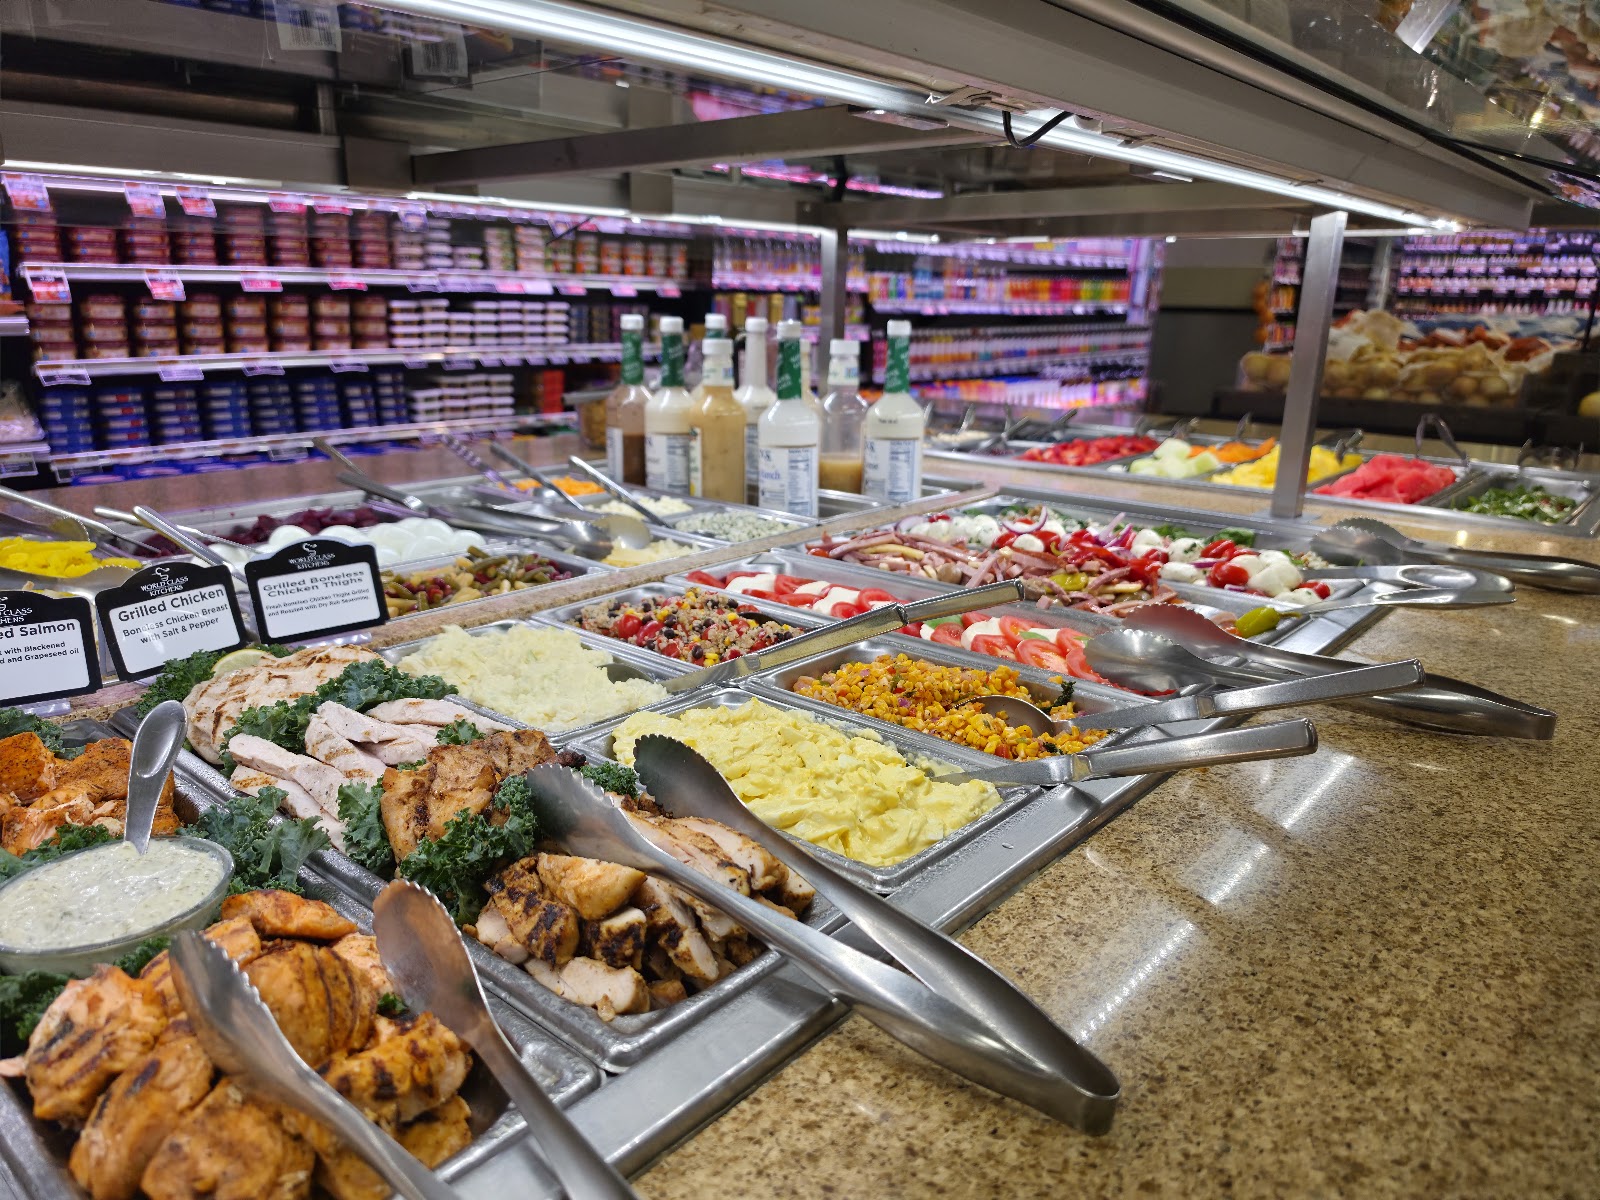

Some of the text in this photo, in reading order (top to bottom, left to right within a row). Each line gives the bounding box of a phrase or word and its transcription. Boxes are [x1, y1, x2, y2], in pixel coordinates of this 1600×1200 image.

[140, 575, 189, 592] WORLD CLASS
[263, 570, 364, 592] Grilled Boneless
[268, 577, 363, 597] Chicken Thighs
[149, 584, 184, 597] KITCHENS
[3, 607, 33, 617] CLASS
[118, 588, 225, 622] Grilled Chicken
[0, 615, 25, 625] HENS
[122, 603, 229, 637] Boneless Chicken Breast
[19, 622, 75, 637] Salmon
[140, 617, 219, 644] with Salt & Pepper
[4, 646, 22, 655] with
[24, 641, 66, 653] Blackened
[7, 655, 23, 664] and
[24, 649, 68, 661] Grapeseed
[69, 647, 80, 656] oil
